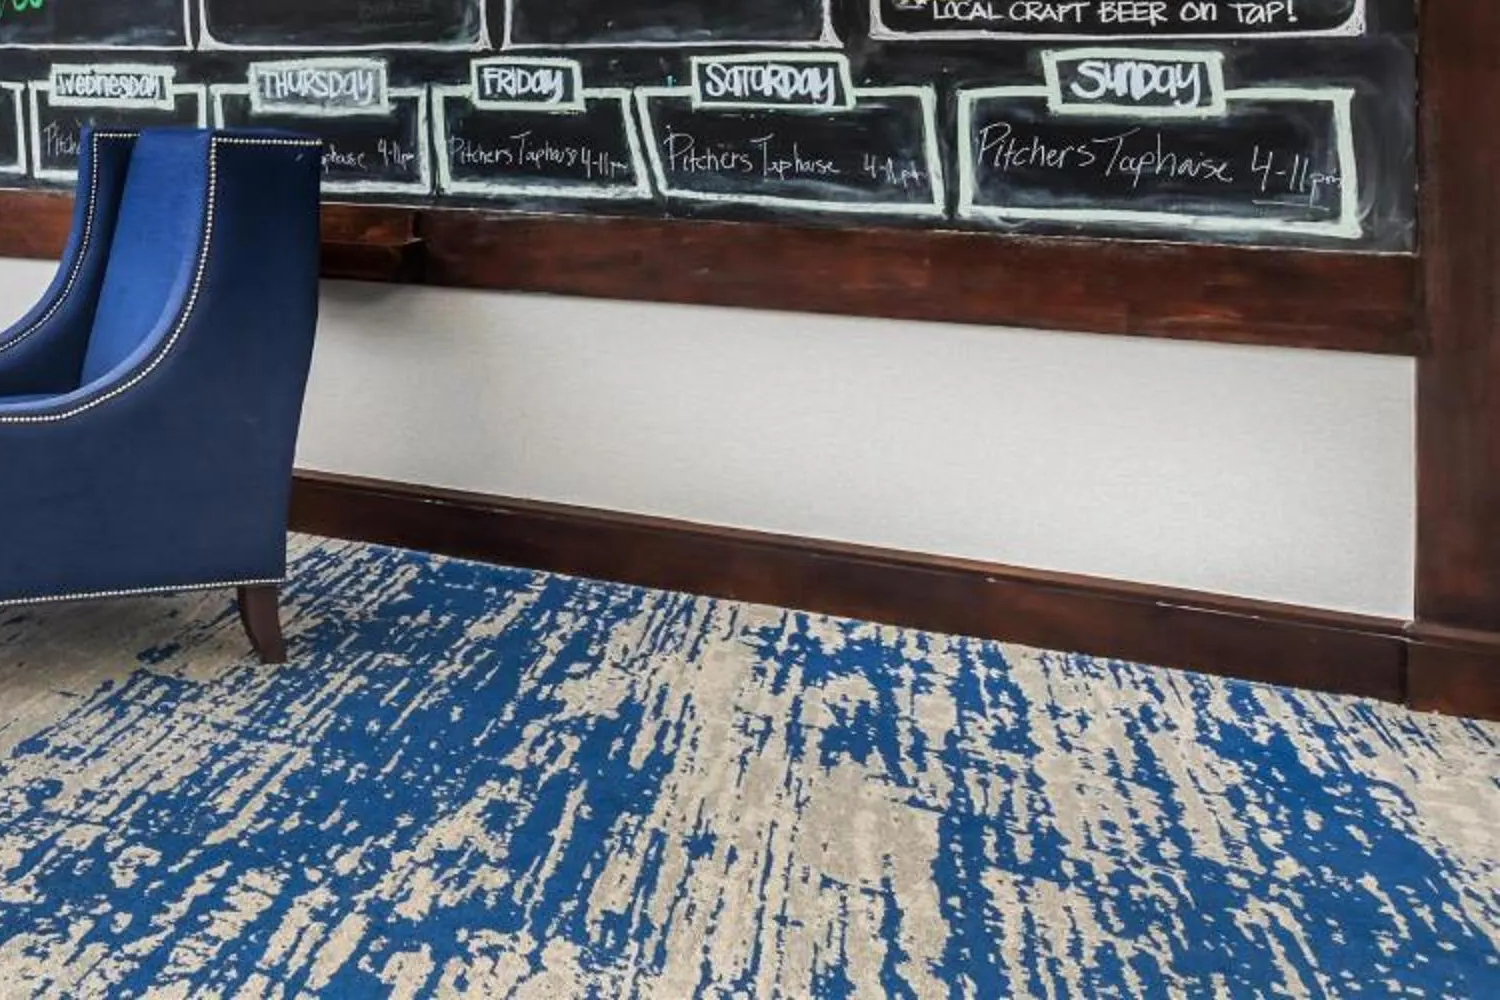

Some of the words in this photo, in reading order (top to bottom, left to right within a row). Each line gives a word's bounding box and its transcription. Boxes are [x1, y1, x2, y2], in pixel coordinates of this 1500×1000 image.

[933, 0, 1002, 21] LOCAL
[1008, 0, 1092, 23] CRAFT
[1097, 2, 1169, 27] BEER
[663, 132, 753, 173] Pitchers
[978, 122, 1095, 169] Pitchers
